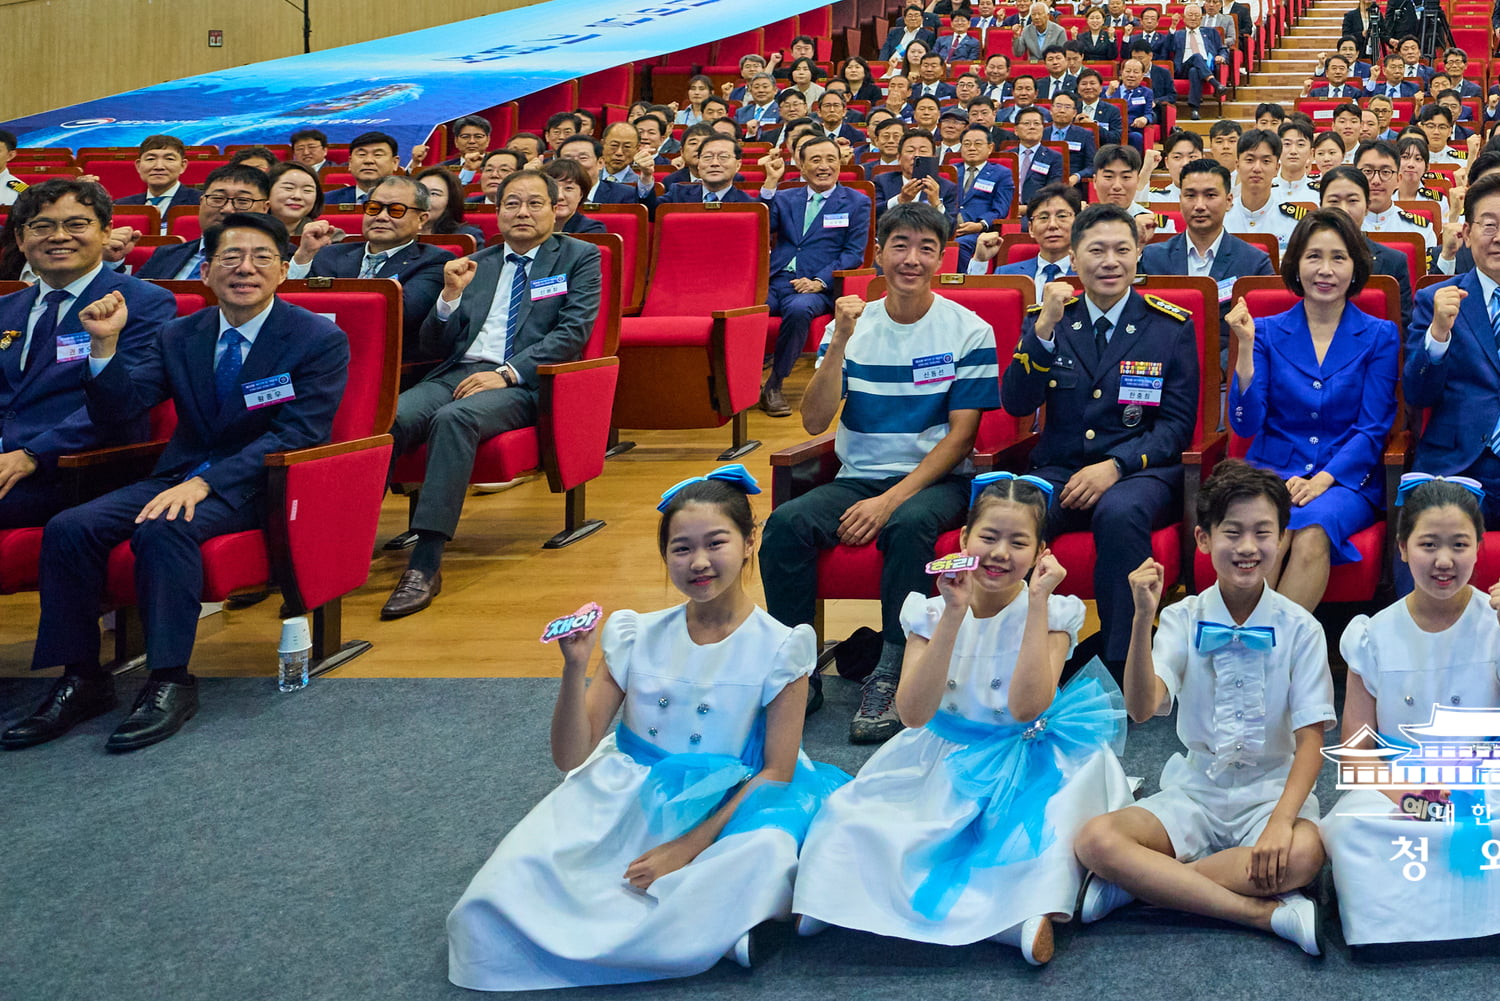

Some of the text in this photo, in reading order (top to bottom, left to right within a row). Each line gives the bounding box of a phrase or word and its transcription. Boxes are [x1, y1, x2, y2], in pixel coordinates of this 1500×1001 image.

[432, 33, 603, 64] 기념식
[931, 557, 975, 570] 하리
[545, 610, 597, 638] 채아
